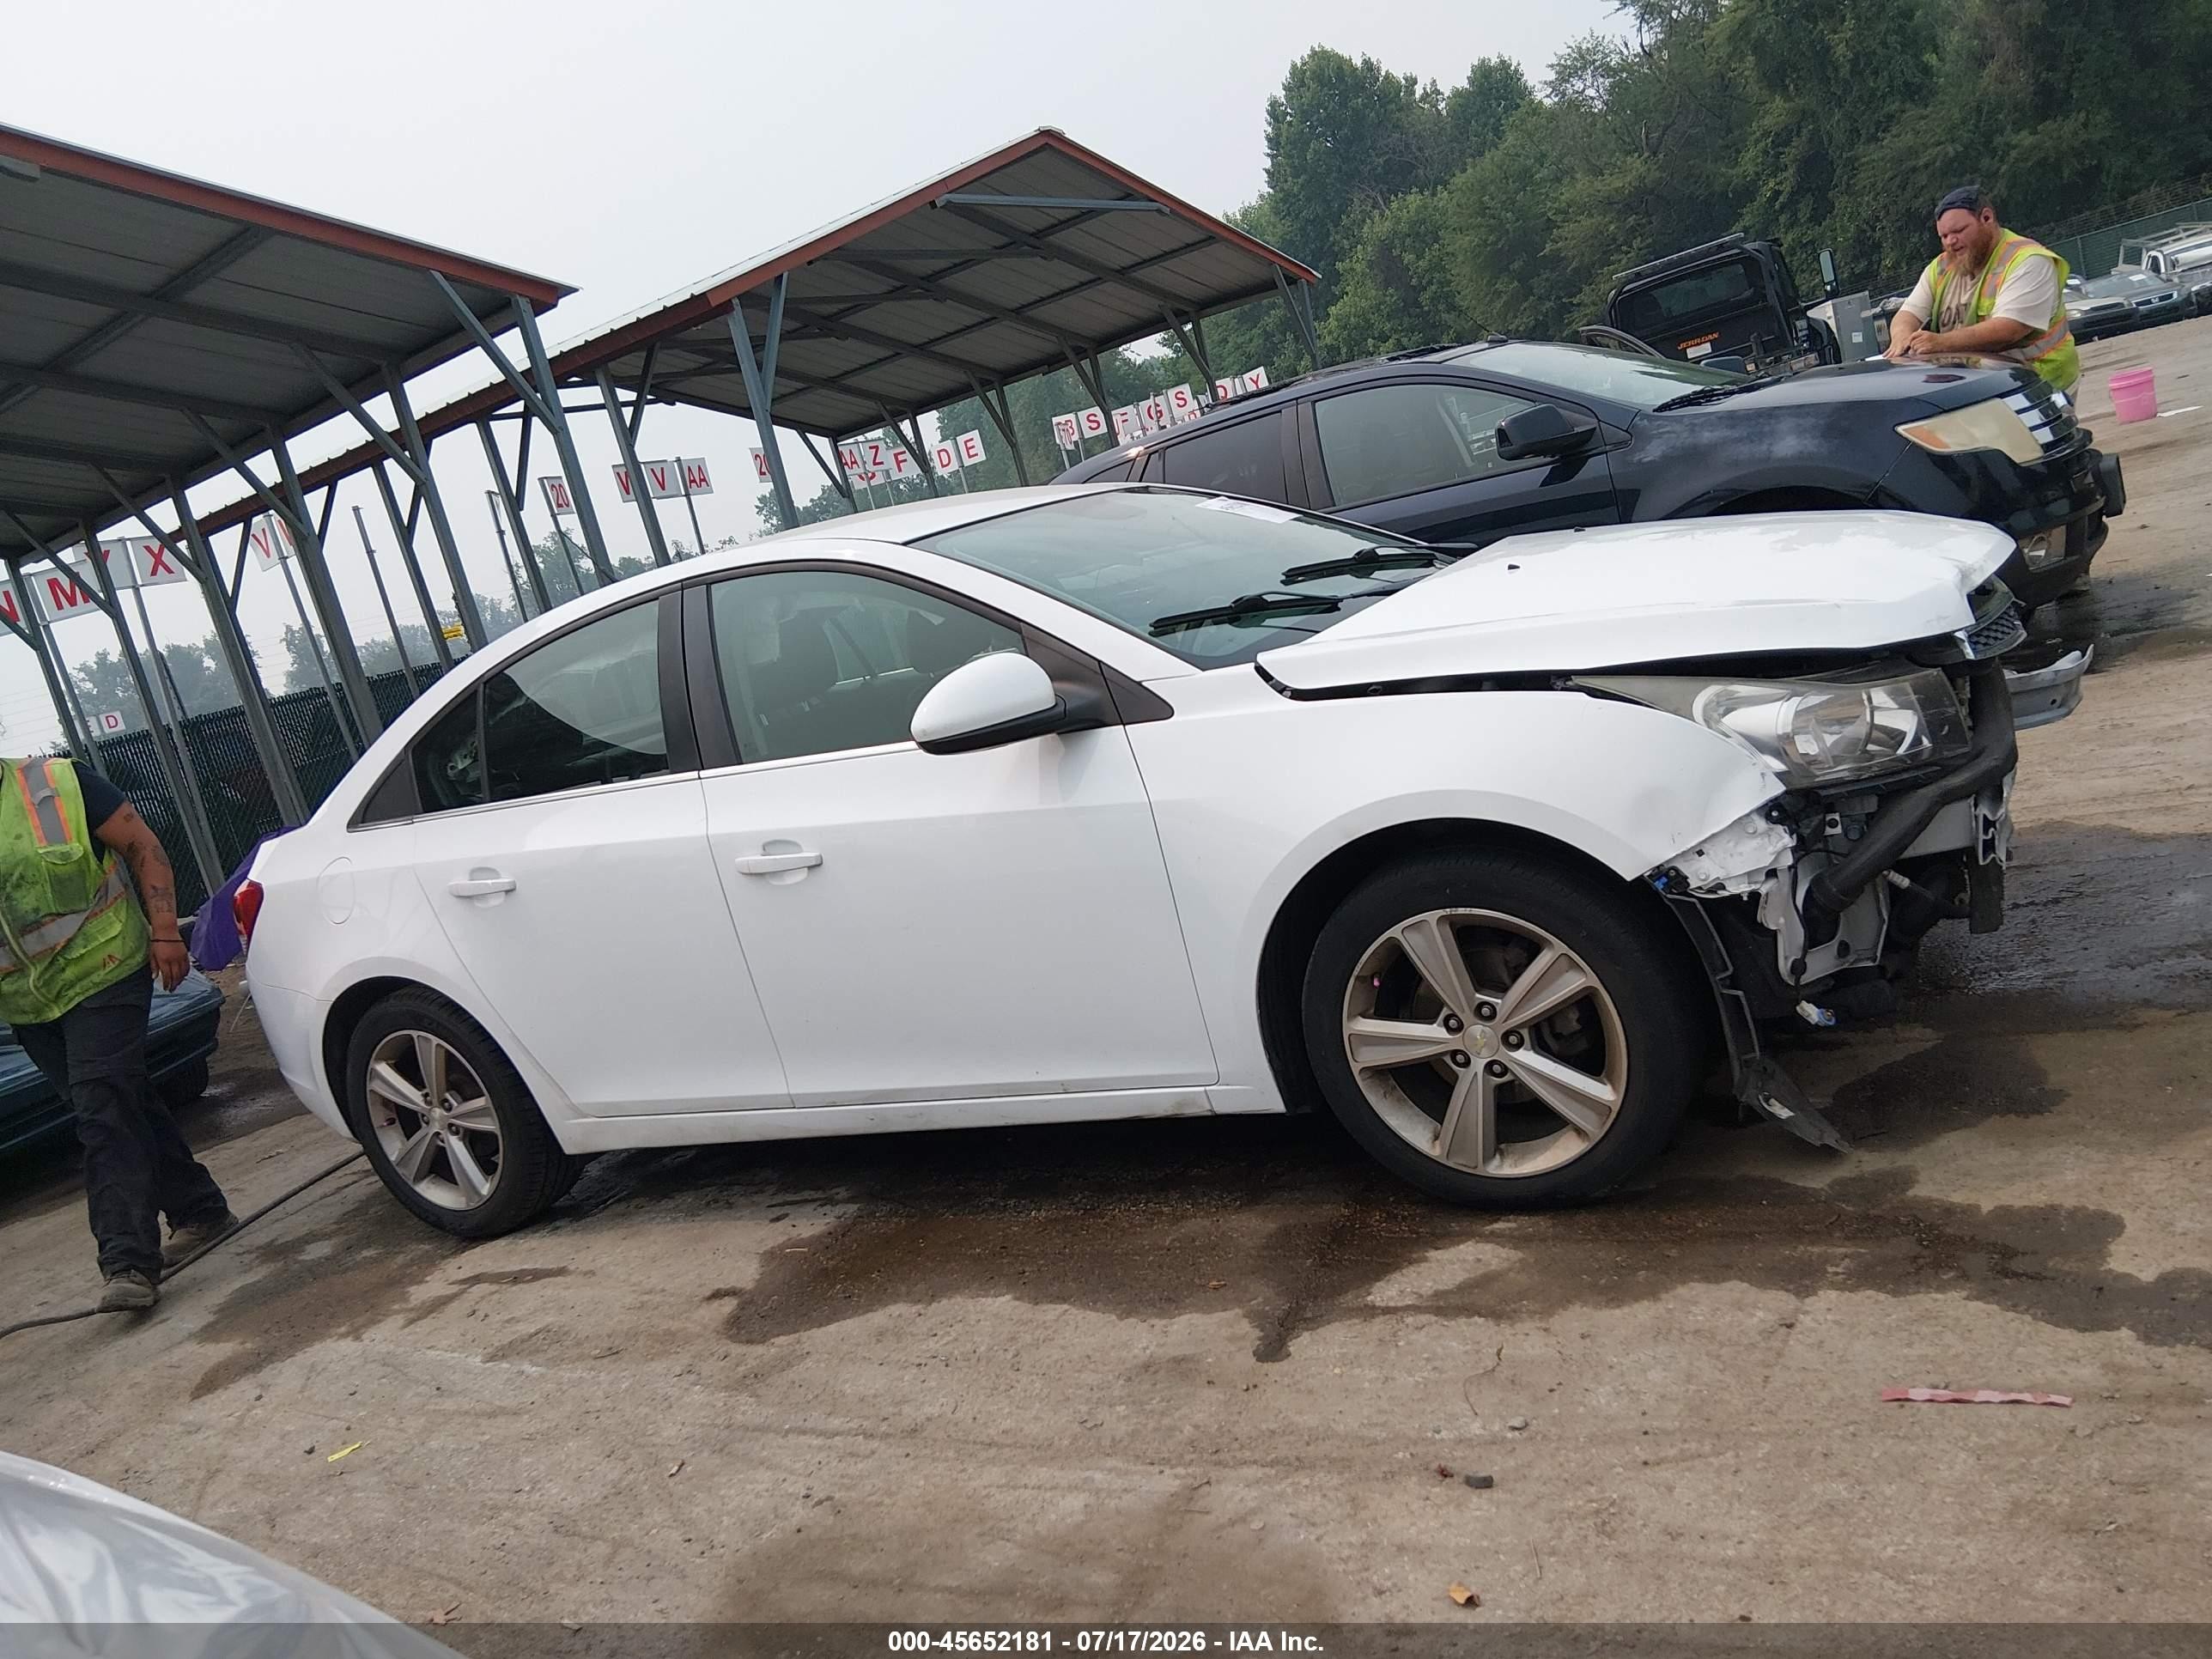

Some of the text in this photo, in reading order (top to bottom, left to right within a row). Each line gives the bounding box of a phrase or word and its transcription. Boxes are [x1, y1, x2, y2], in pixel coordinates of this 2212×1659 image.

[1249, 374, 1260, 389] Y
[1175, 391, 1188, 408] S
[1086, 413, 1101, 431] S
[1147, 403, 1164, 421] G
[868, 445, 884, 466] Z
[937, 448, 951, 469] D
[963, 437, 979, 459] E
[893, 450, 908, 473] F
[651, 467, 665, 491] V
[688, 465, 709, 489] AA
[550, 483, 570, 508] 20
[143, 544, 175, 577] X
[46, 572, 90, 611] M
[106, 714, 118, 729] D
